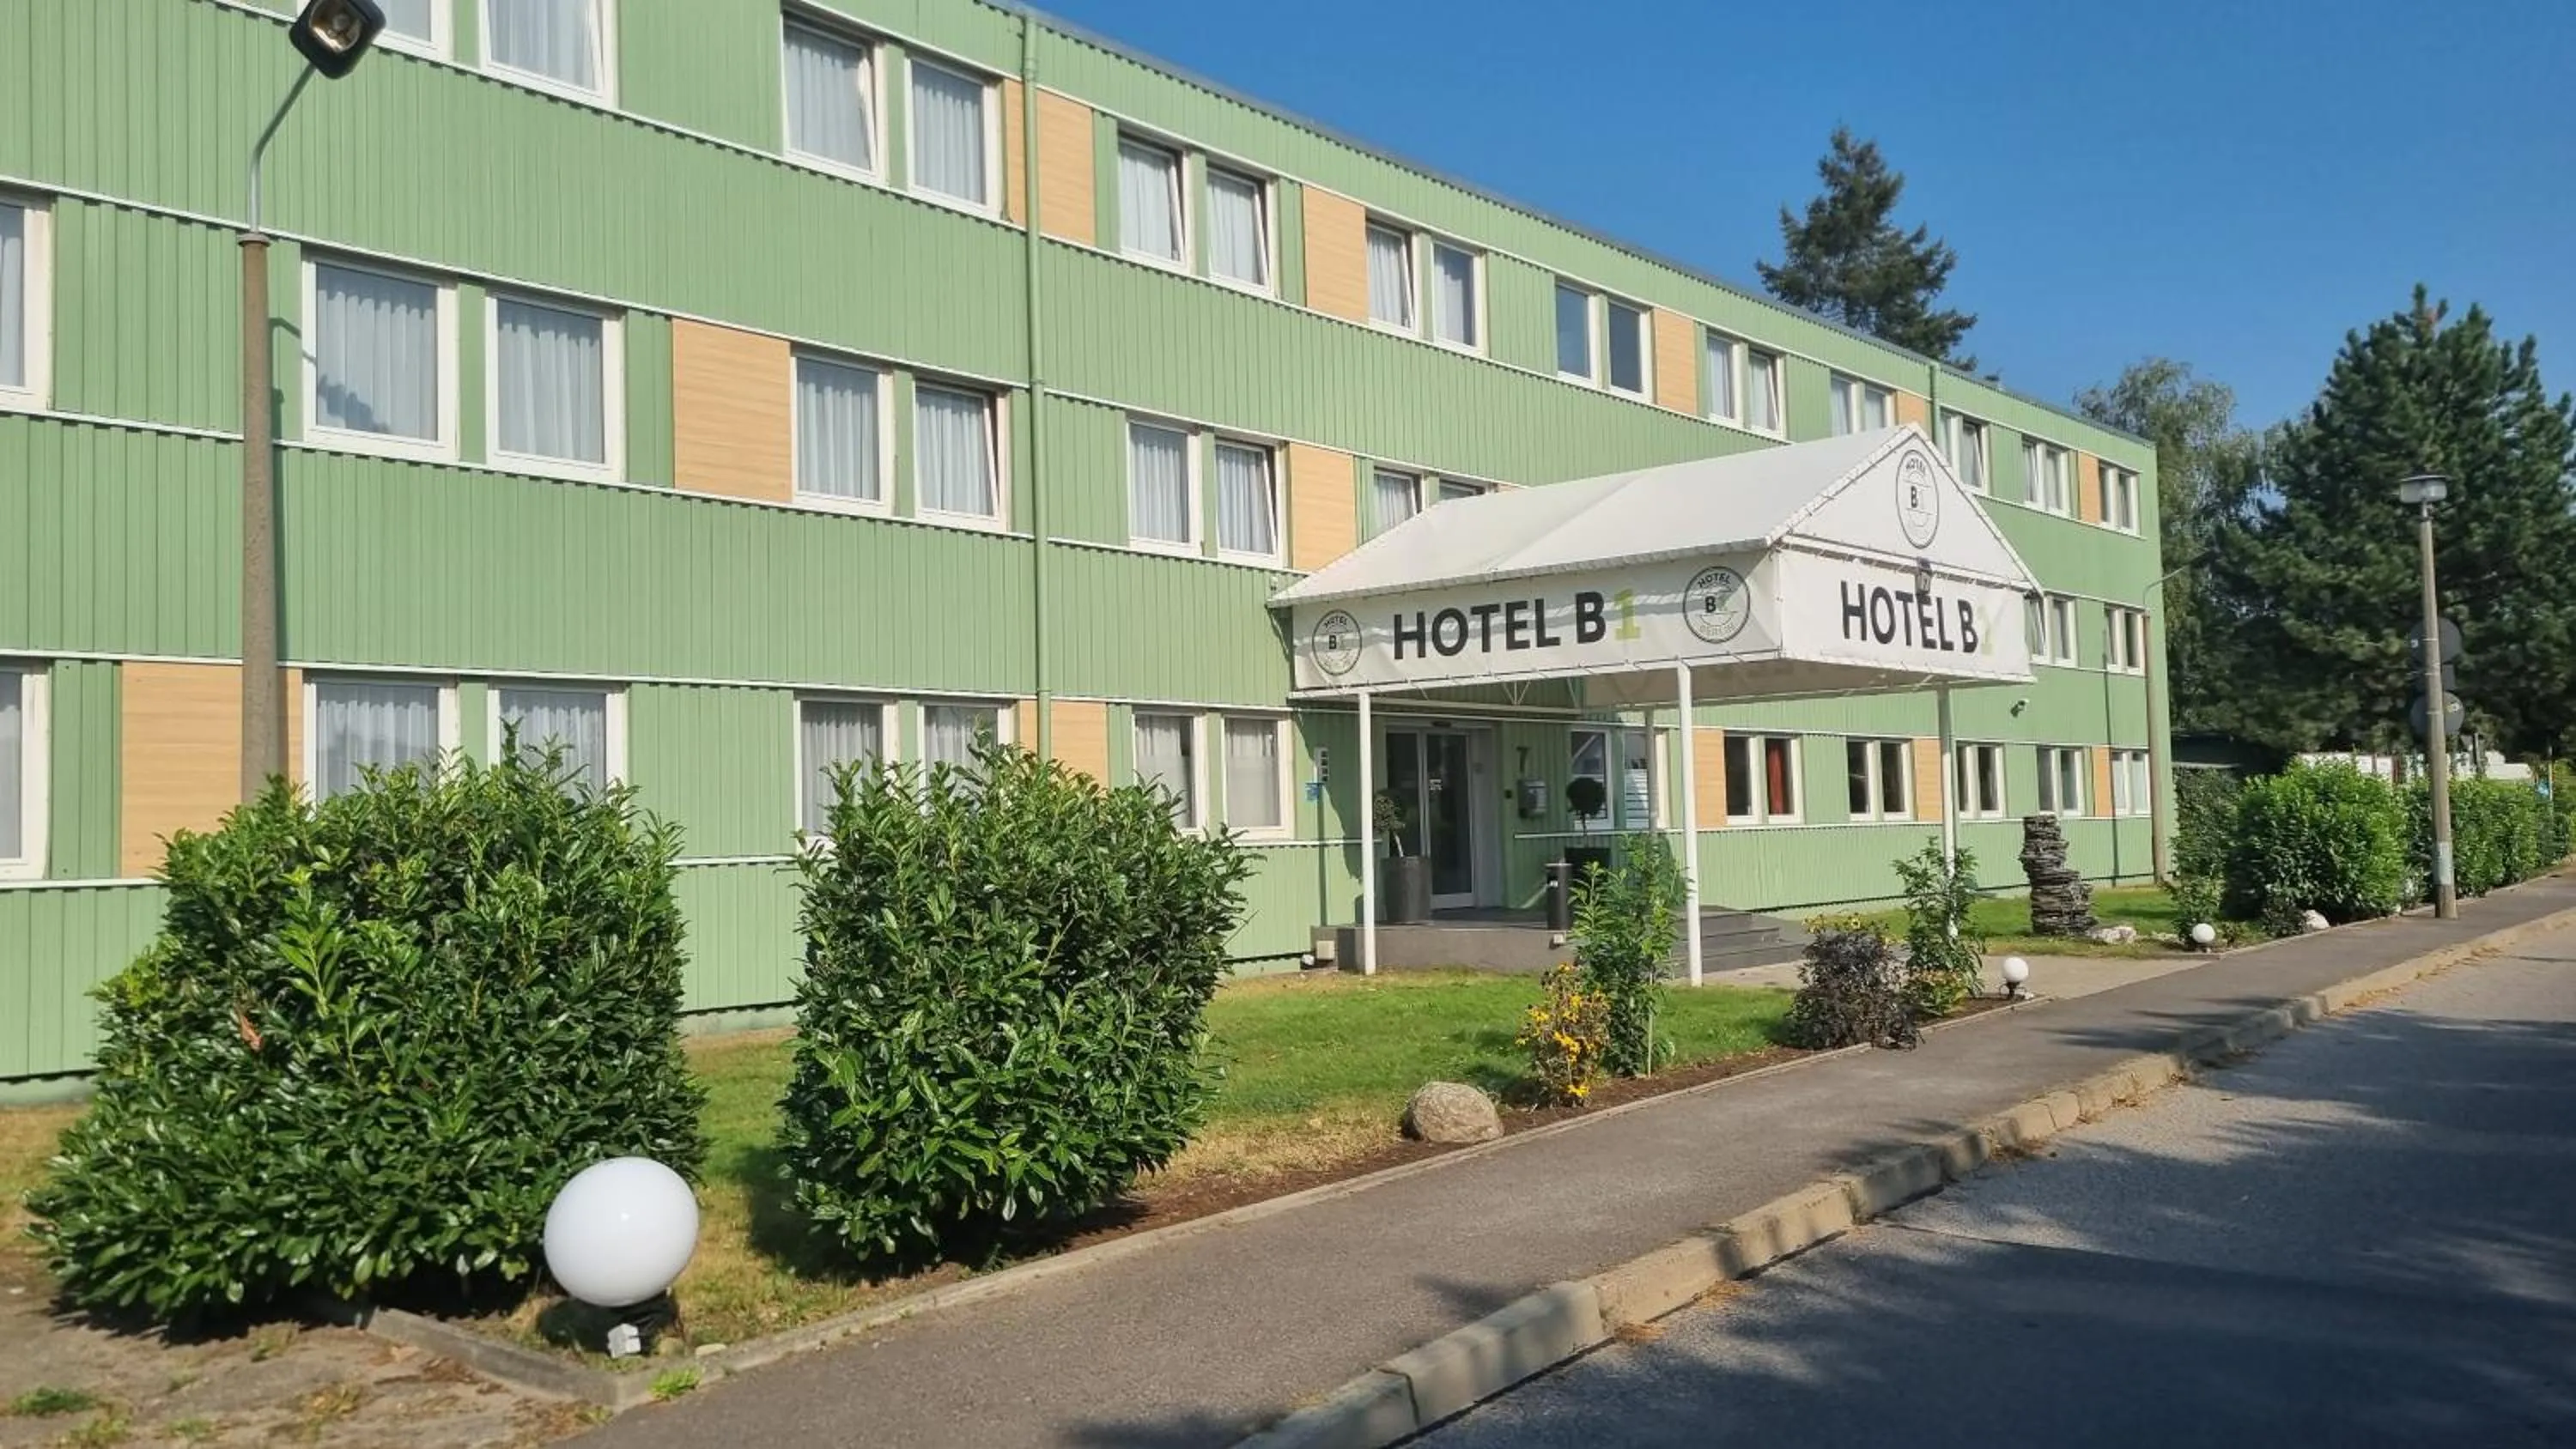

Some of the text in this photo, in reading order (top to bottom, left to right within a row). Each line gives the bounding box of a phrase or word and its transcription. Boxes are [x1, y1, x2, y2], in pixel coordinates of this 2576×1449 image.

[1698, 572, 1731, 589] HOTEL
[1394, 589, 1641, 659] HOTEL B1
[1840, 580, 1954, 651] HOTEL
[1516, 746, 1530, 773] 7
